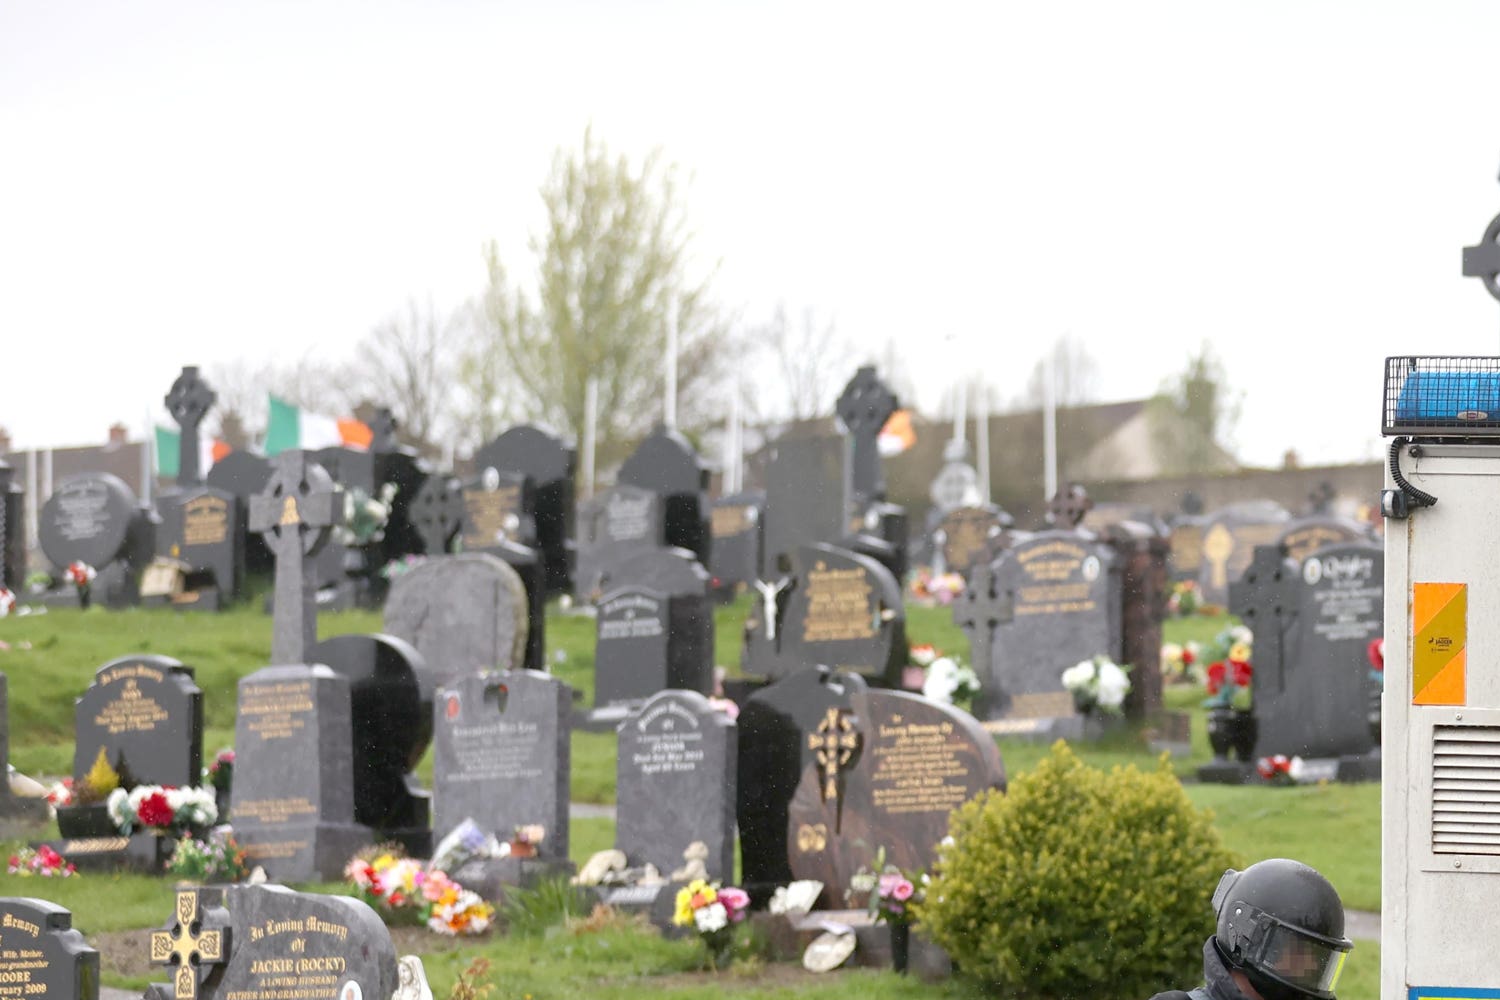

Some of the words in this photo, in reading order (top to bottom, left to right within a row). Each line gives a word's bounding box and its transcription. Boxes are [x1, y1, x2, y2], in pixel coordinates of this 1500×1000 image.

[2, 913, 40, 938] Memory
[266, 919, 304, 937] Loving
[305, 915, 349, 941] Memory
[250, 958, 295, 975] JACKIE
[296, 956, 346, 975] (ROCKY)
[0, 970, 31, 983] OORE
[299, 975, 338, 986] HUSBAND
[0, 986, 23, 997] ruary
[277, 988, 338, 1000] GRANDFATHER
